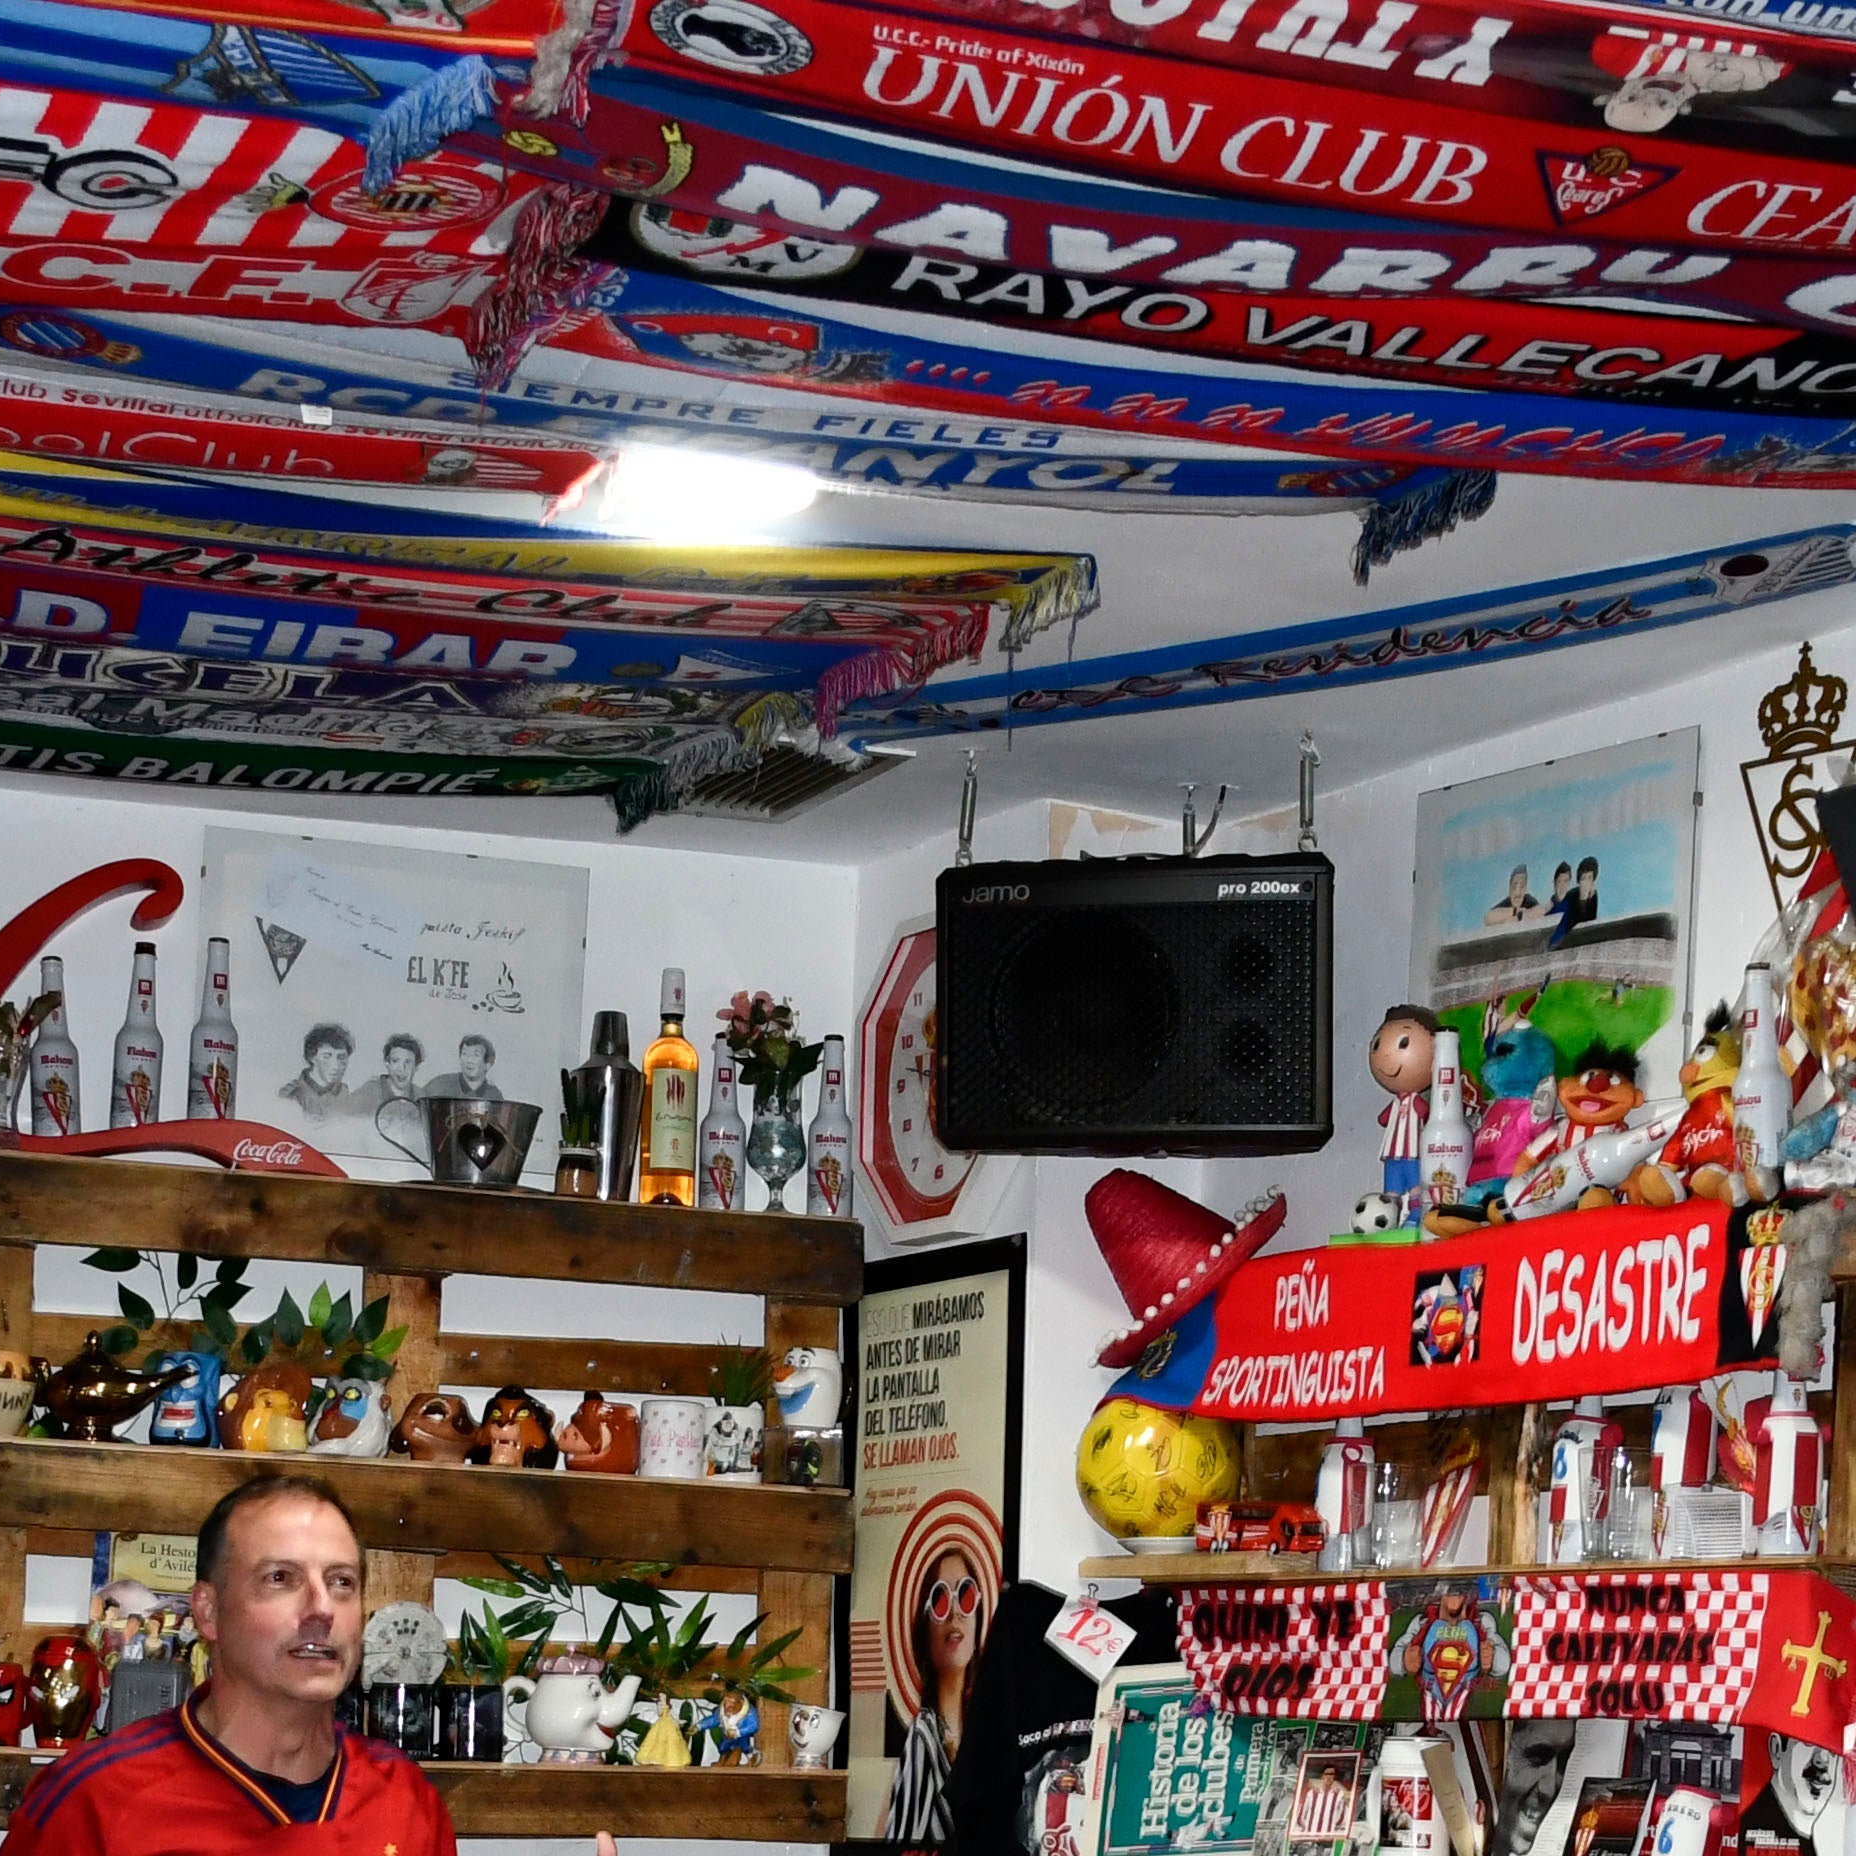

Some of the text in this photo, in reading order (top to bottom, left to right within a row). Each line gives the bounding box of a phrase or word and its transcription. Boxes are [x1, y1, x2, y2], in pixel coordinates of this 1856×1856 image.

[934, 36, 1086, 77] Pride of Xixón
[1414, 16, 1514, 87] Y
[861, 46, 1488, 206] UNIÓN CLUB
[1, 242, 329, 307] C.F.
[889, 256, 1214, 335] RAYO
[235, 367, 498, 422] RCD
[813, 413, 1064, 448] FIELES
[472, 587, 735, 630] Club
[1193, 594, 1653, 687] Residencia
[122, 754, 507, 798] BALOMPIÉ
[961, 880, 1031, 904] Jamo
[1216, 879, 1301, 900] pro 200ex
[406, 955, 428, 985] EL
[708, 1130, 741, 1144] Mahou
[814, 1133, 848, 1146] Mahou
[1427, 1143, 1464, 1155] Mahou
[912, 1291, 986, 1330] MIRÁBAMOS
[1274, 1258, 1331, 1333] PEÑA
[1511, 1222, 1711, 1368] DESASTRE
[865, 1329, 962, 1371] ANTES DE MIRAR
[865, 1367, 941, 1404] LA PANTALLA
[1204, 1344, 1386, 1410] SPORTINGUISTA
[864, 1399, 949, 1437] DEL TELÉFONO,
[863, 1432, 961, 1471] SE LLAMAN OJOS.
[140, 1542, 196, 1559] La Hesto
[149, 1556, 196, 1573] d'Avilé
[1584, 1584, 1686, 1617] NUNCA
[1192, 1599, 1358, 1645] QUINI YE
[1140, 1700, 1182, 1839] Historia
[1175, 1715, 1208, 1818] de los
[1200, 1708, 1235, 1823] clubes
[1239, 1720, 1266, 1805] Primera
[1657, 1817, 1675, 1854] 6
